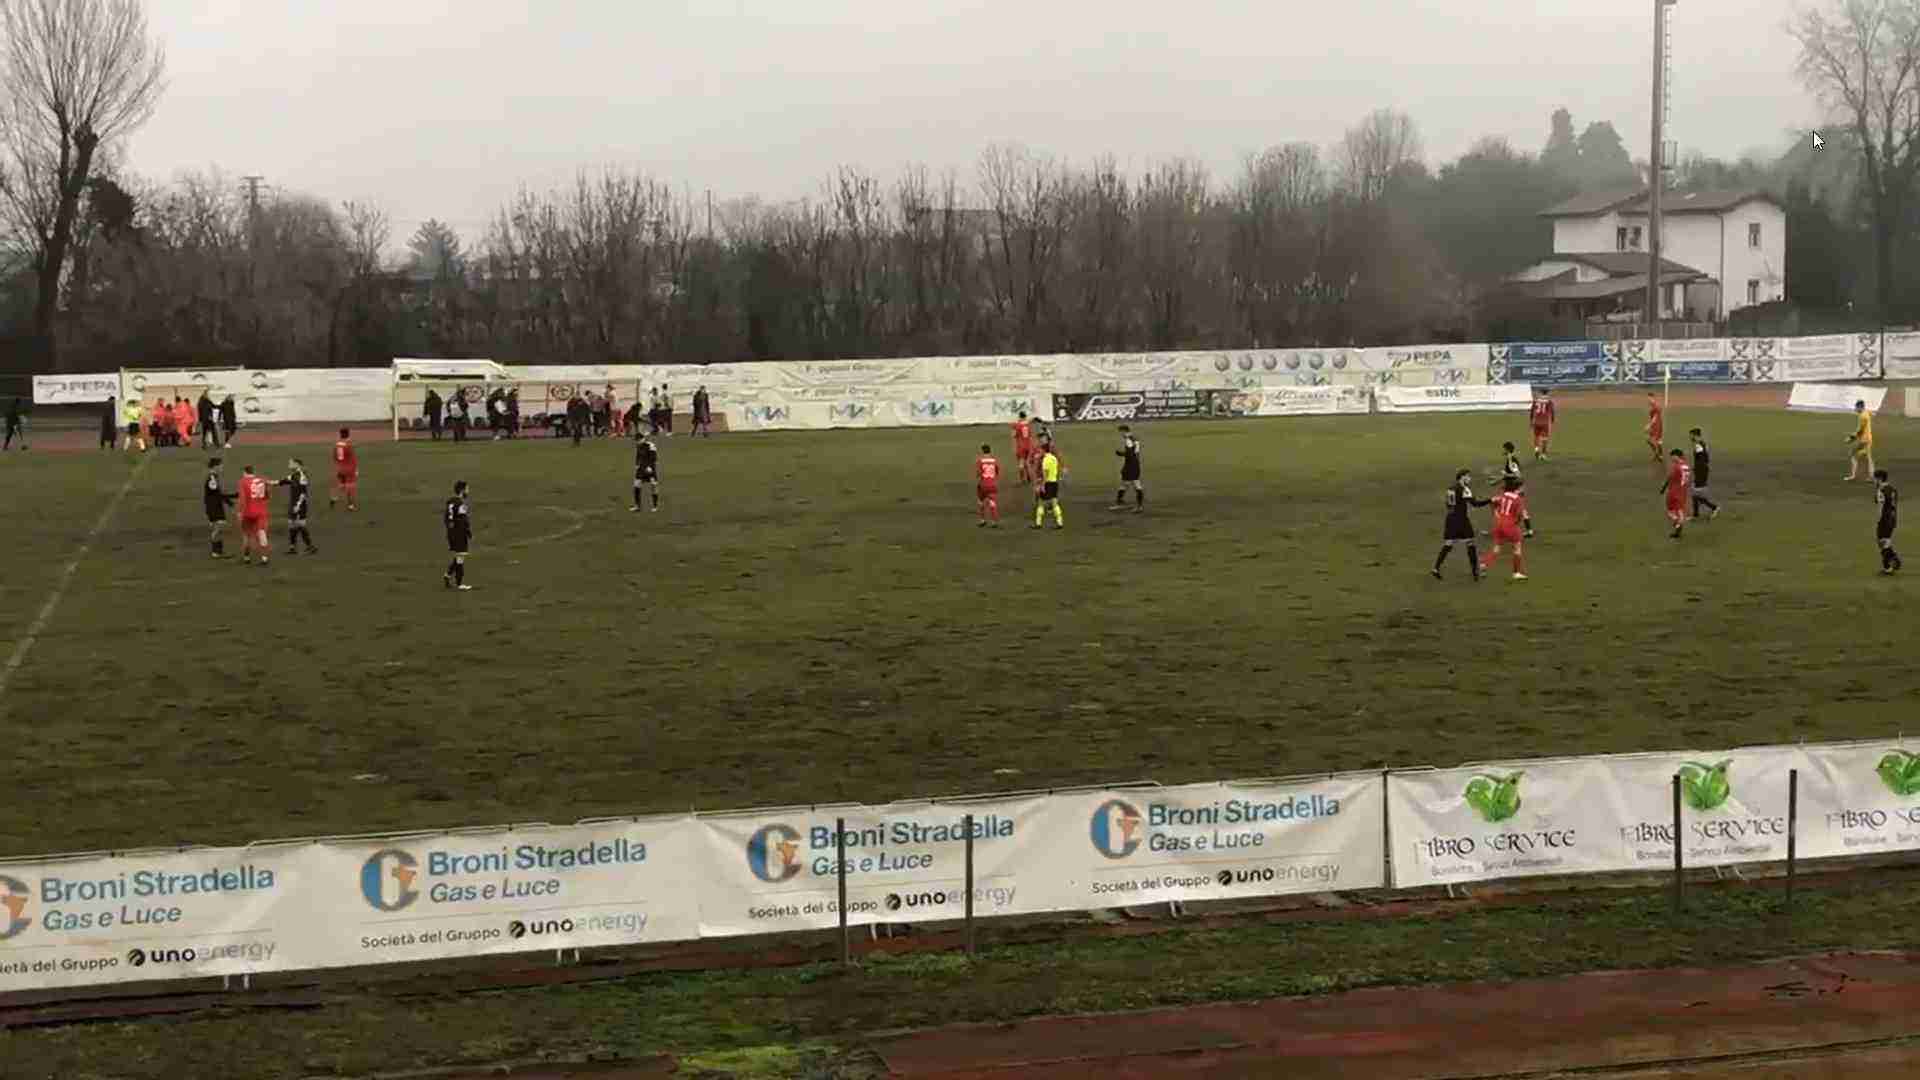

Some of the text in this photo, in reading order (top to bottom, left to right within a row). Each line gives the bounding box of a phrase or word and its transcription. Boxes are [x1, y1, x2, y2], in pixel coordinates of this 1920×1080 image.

[1148, 794, 1341, 827] Broni Stradella
[1824, 809, 1887, 832] FIBRO
[1150, 830, 1264, 852] Gas e Luce
[1484, 829, 1576, 854] SERVICE
[1690, 817, 1785, 843] SERVICE
[428, 838, 646, 877] Broni Stradella
[860, 857, 873, 873] e
[879, 851, 933, 872] Luce
[40, 865, 274, 904] Broni Stradella
[430, 877, 561, 903] Gas e Luce
[1091, 879, 1139, 894] Società
[1141, 876, 1162, 890] del
[1164, 874, 1211, 889] Gruppo
[43, 904, 182, 932] Gas e Luce
[748, 903, 799, 920] Società
[803, 901, 824, 915] del
[828, 901, 879, 915] Gppo
[361, 932, 416, 949] Società
[419, 930, 442, 946] del
[446, 927, 501, 944] Gruppo
[33, 959, 56, 973] del
[60, 957, 119, 972] Gruppo
